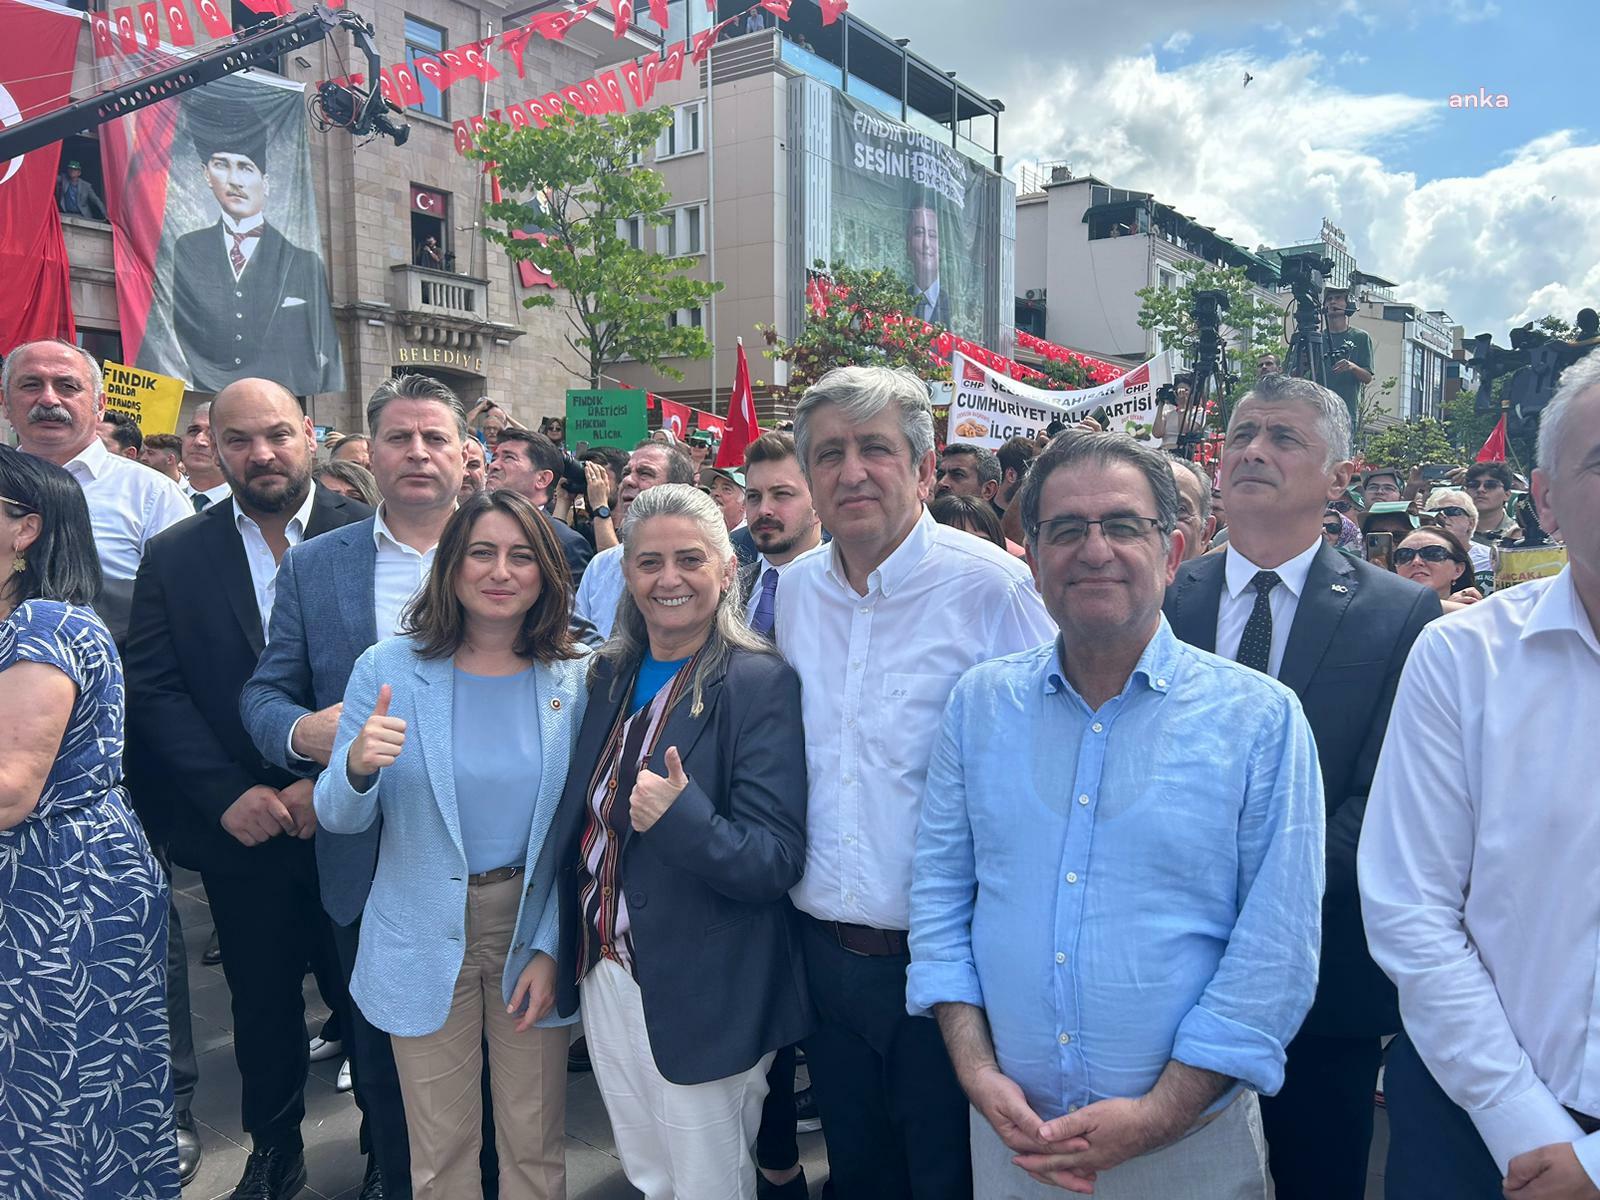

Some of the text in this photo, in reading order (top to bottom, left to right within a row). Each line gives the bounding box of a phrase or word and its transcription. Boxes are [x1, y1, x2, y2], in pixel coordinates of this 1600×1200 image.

[854, 143, 910, 179] SESİNİ
[400, 347, 482, 371] BELEDİYE
[103, 367, 158, 391] FINDIK
[963, 380, 985, 390] CHP
[1125, 383, 1148, 395] CHP
[107, 383, 136, 397] DALDA
[106, 396, 142, 413] ATANDAŞ
[957, 392, 1152, 424] CUMHURİYET HALK ARTİSİ
[990, 420, 1021, 441] İLÇE
